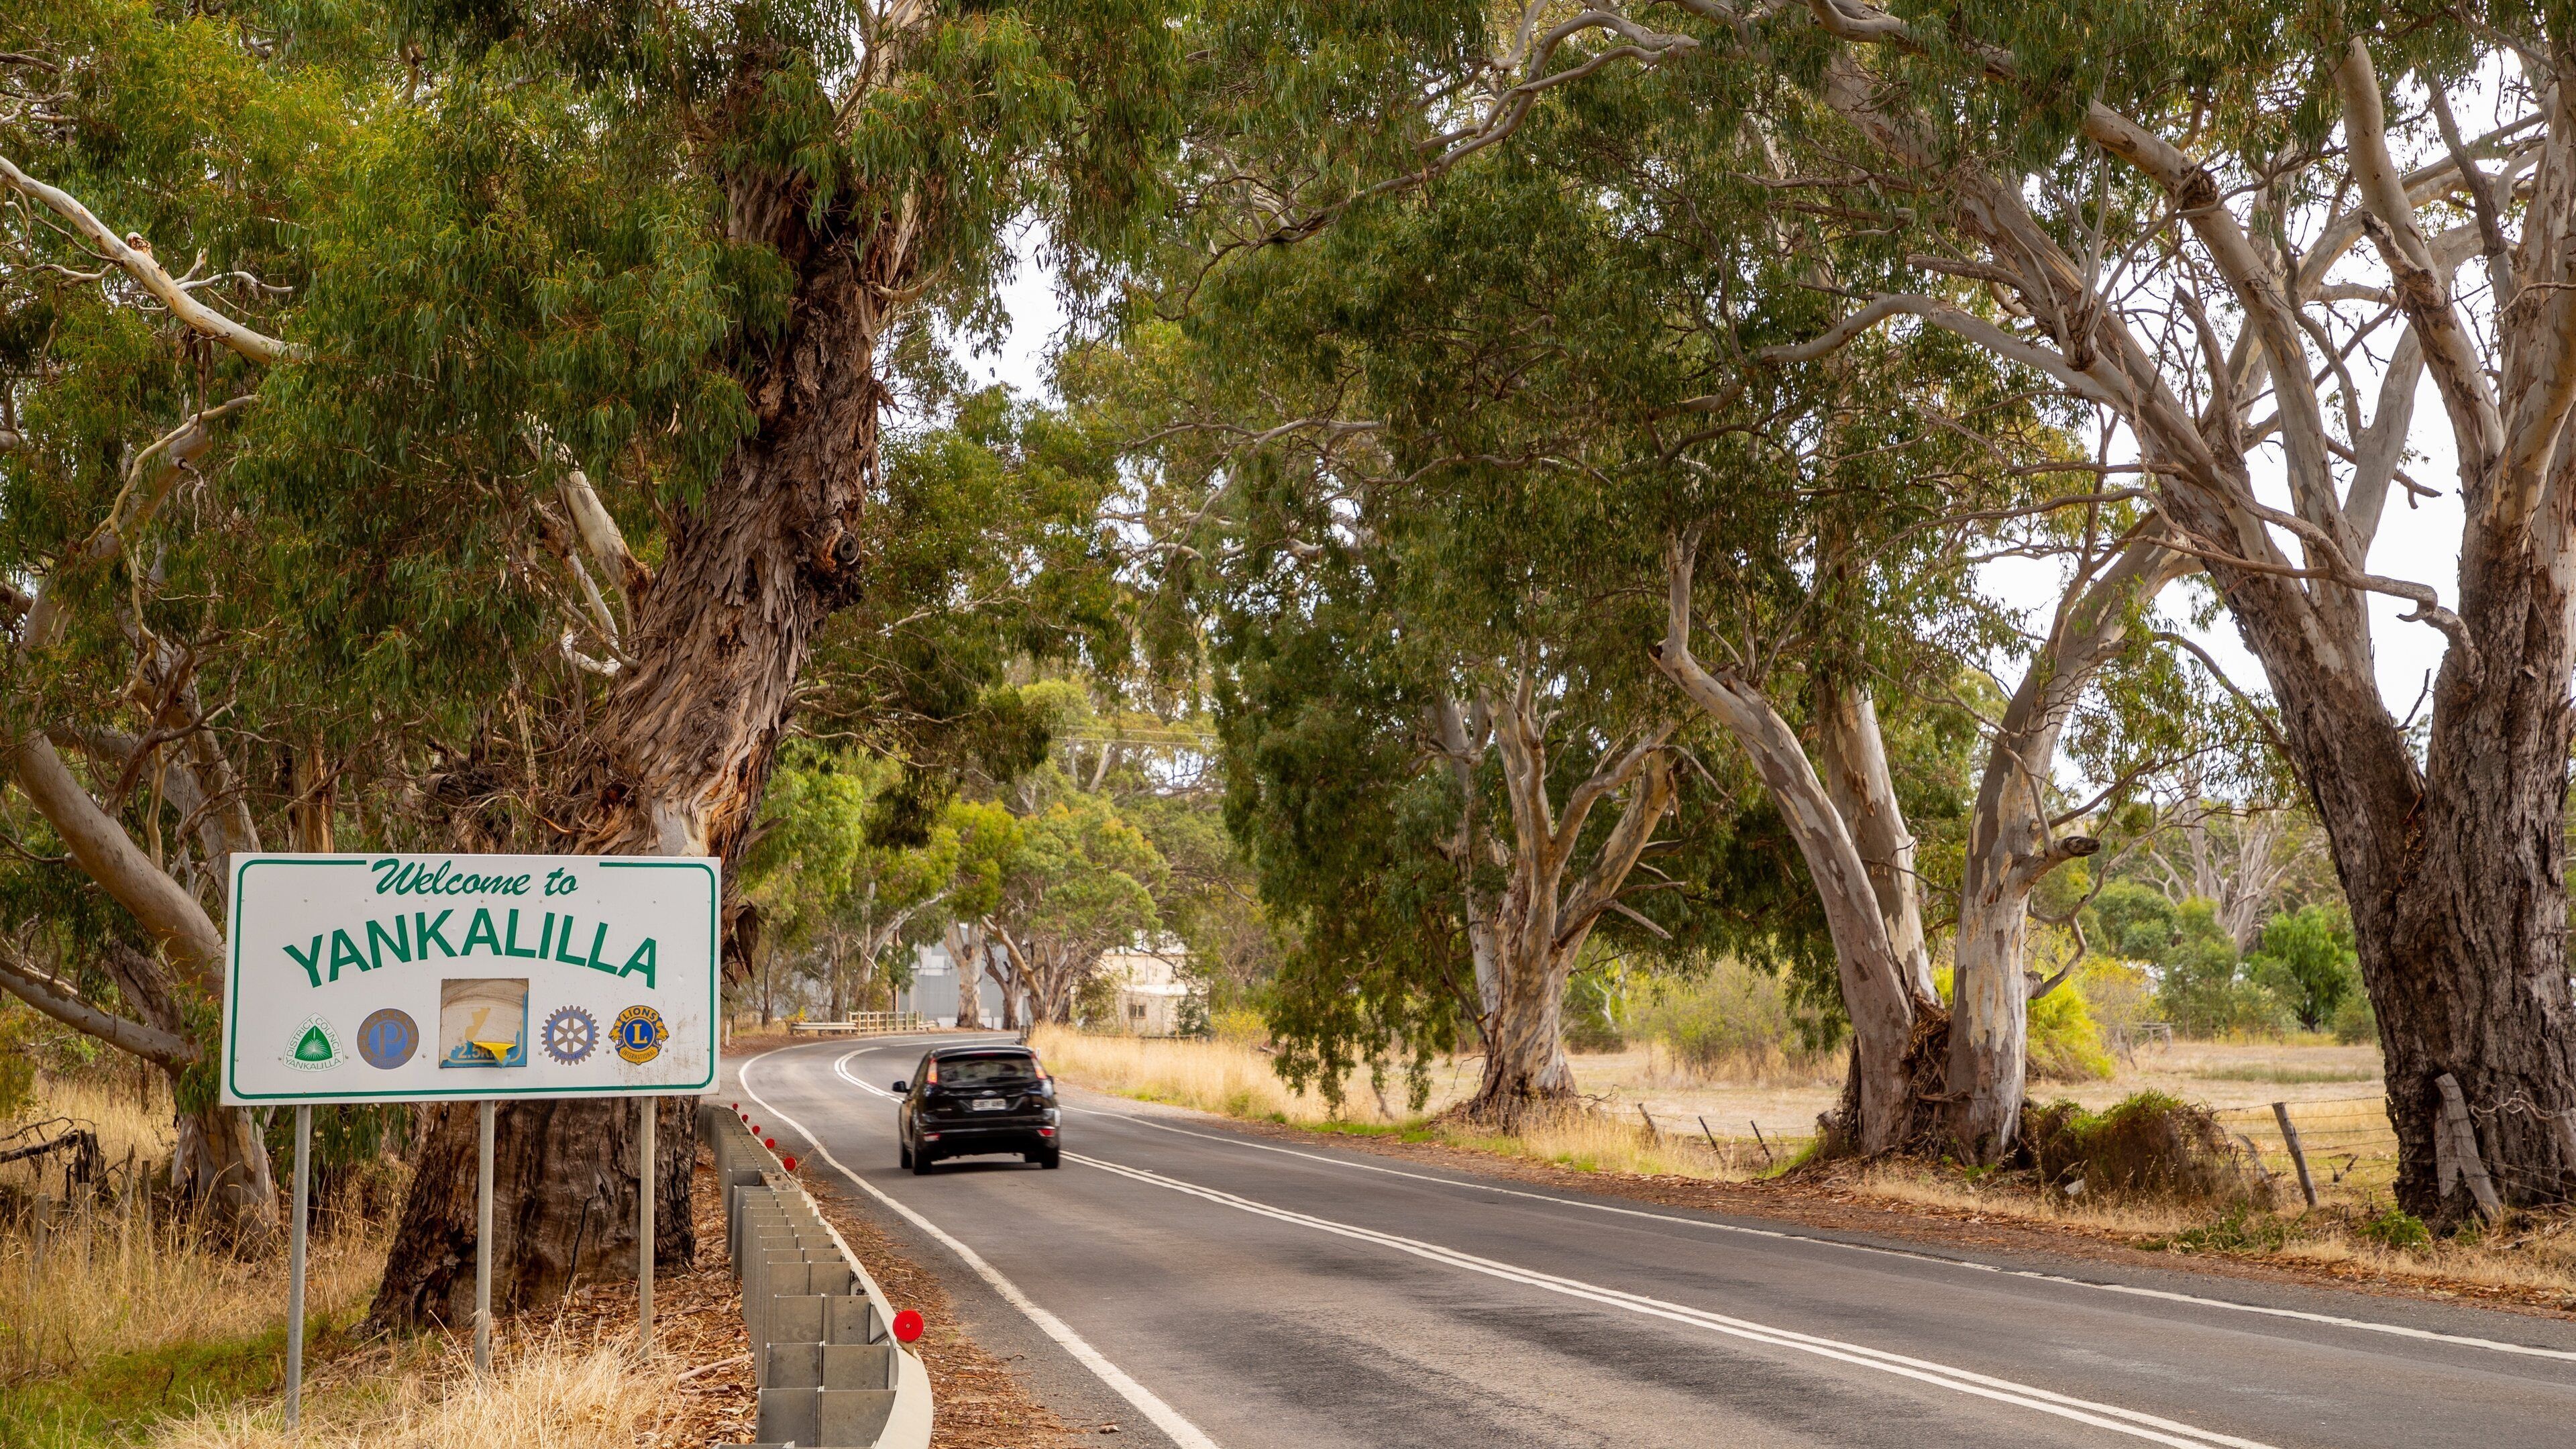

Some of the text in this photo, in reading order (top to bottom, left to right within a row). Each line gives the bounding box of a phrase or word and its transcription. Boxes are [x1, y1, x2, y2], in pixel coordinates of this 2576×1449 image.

[371, 858, 578, 896] Welcome to
[282, 908, 657, 989] YANKALILLA
[622, 1008, 657, 1020] LIONS
[286, 1017, 341, 1057] DISTRICT COUNCIL
[632, 1023, 648, 1044] L
[285, 1057, 341, 1070] YANKALILLA
[621, 1049, 656, 1061] INTERNATIONAL
